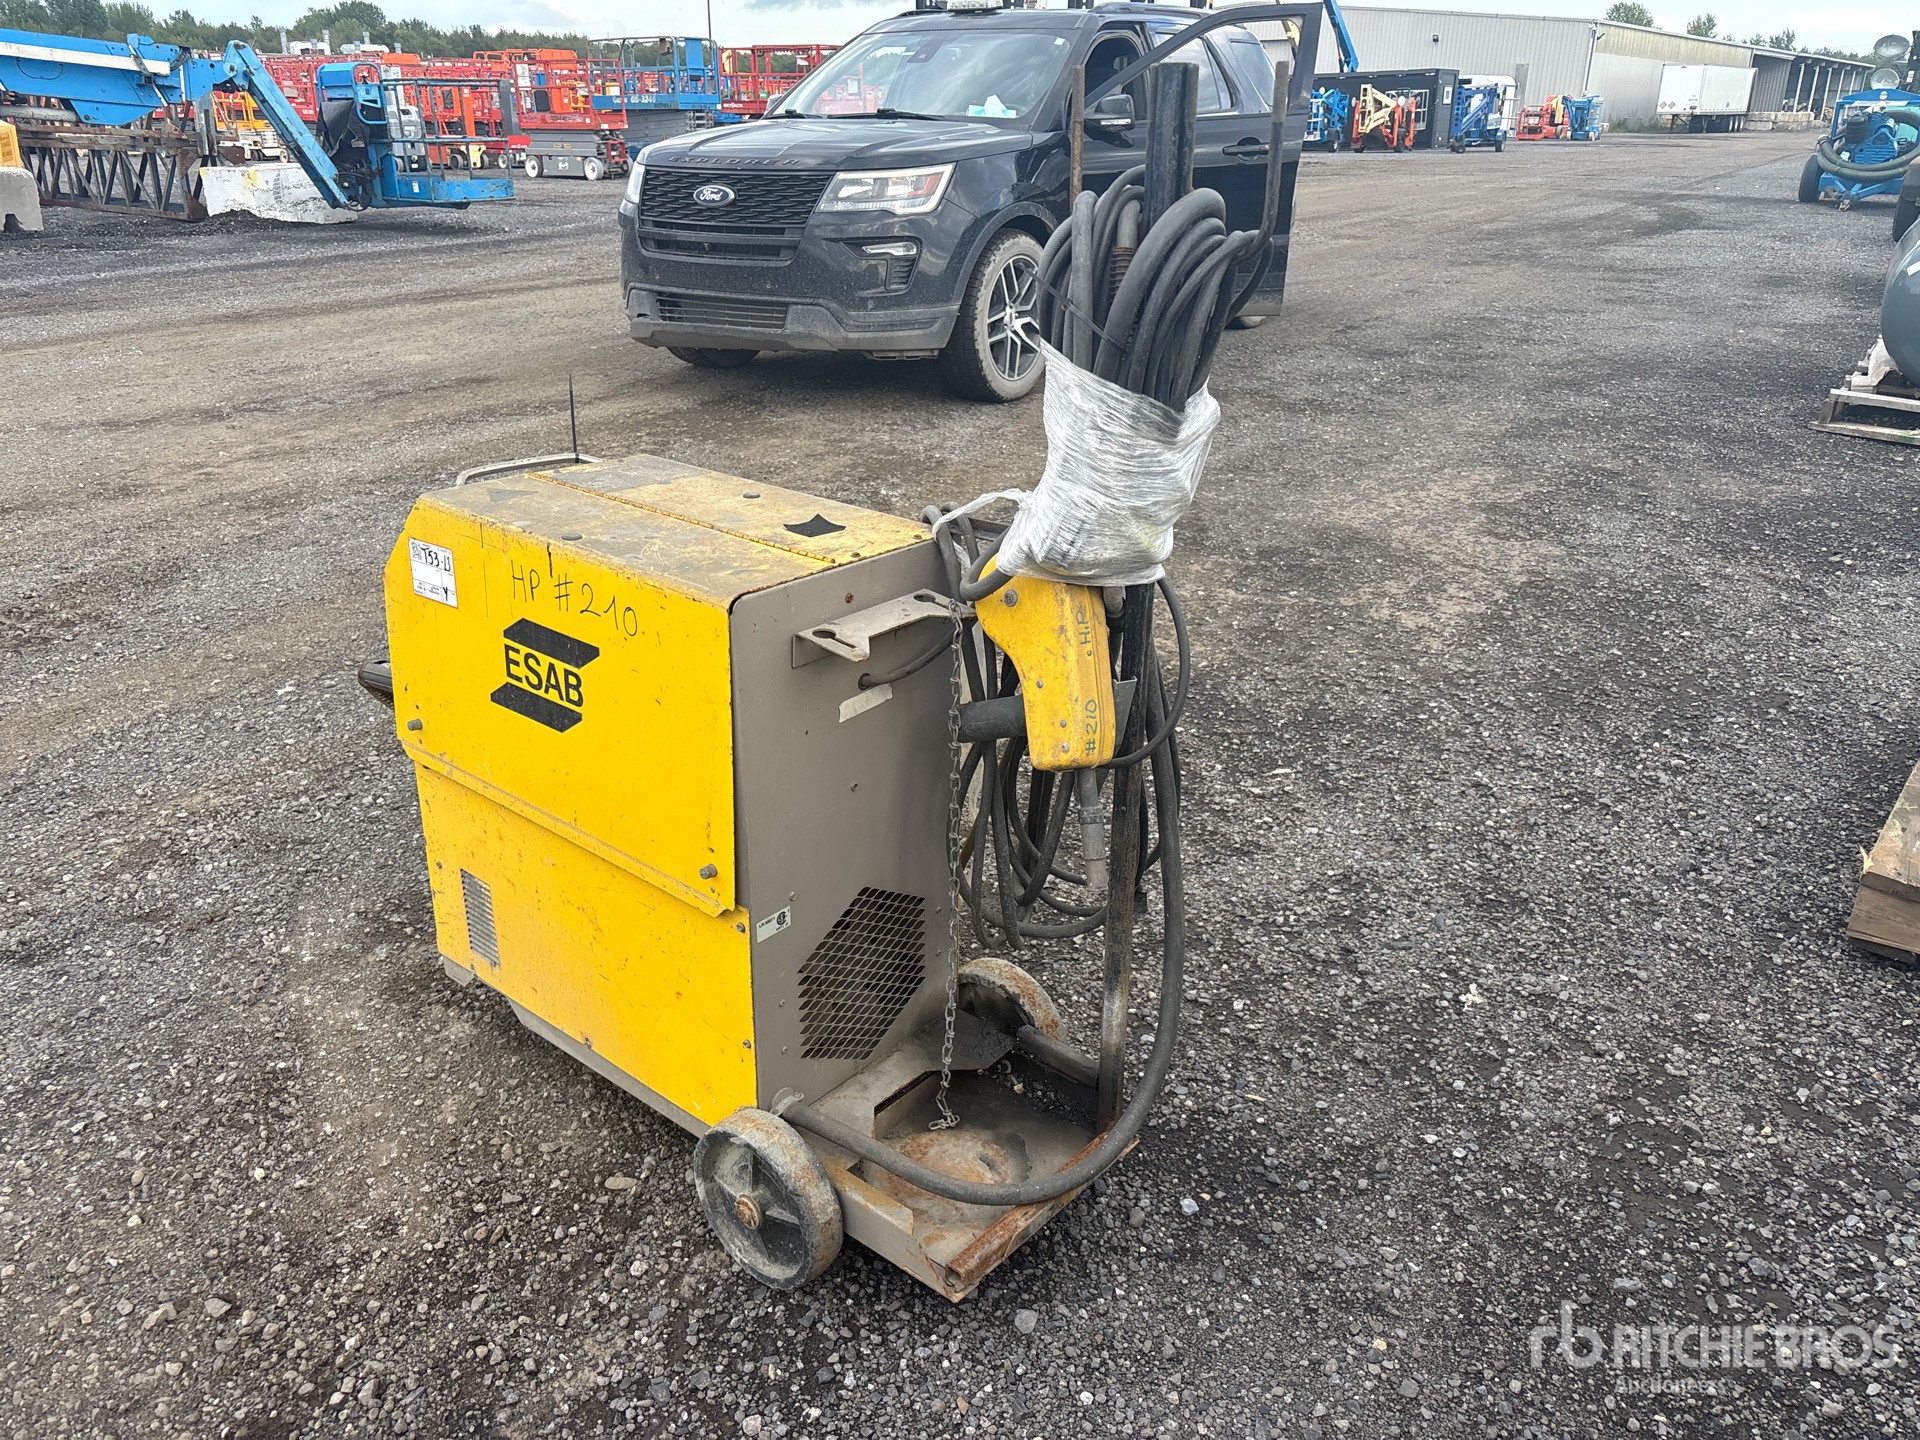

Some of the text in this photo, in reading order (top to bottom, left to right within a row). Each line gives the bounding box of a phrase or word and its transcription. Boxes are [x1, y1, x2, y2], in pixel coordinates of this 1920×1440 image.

[668, 155, 799, 166] EXPLORER
[700, 187, 722, 201] Ford
[511, 560, 638, 637] HP #210
[504, 643, 584, 708] ESAB
